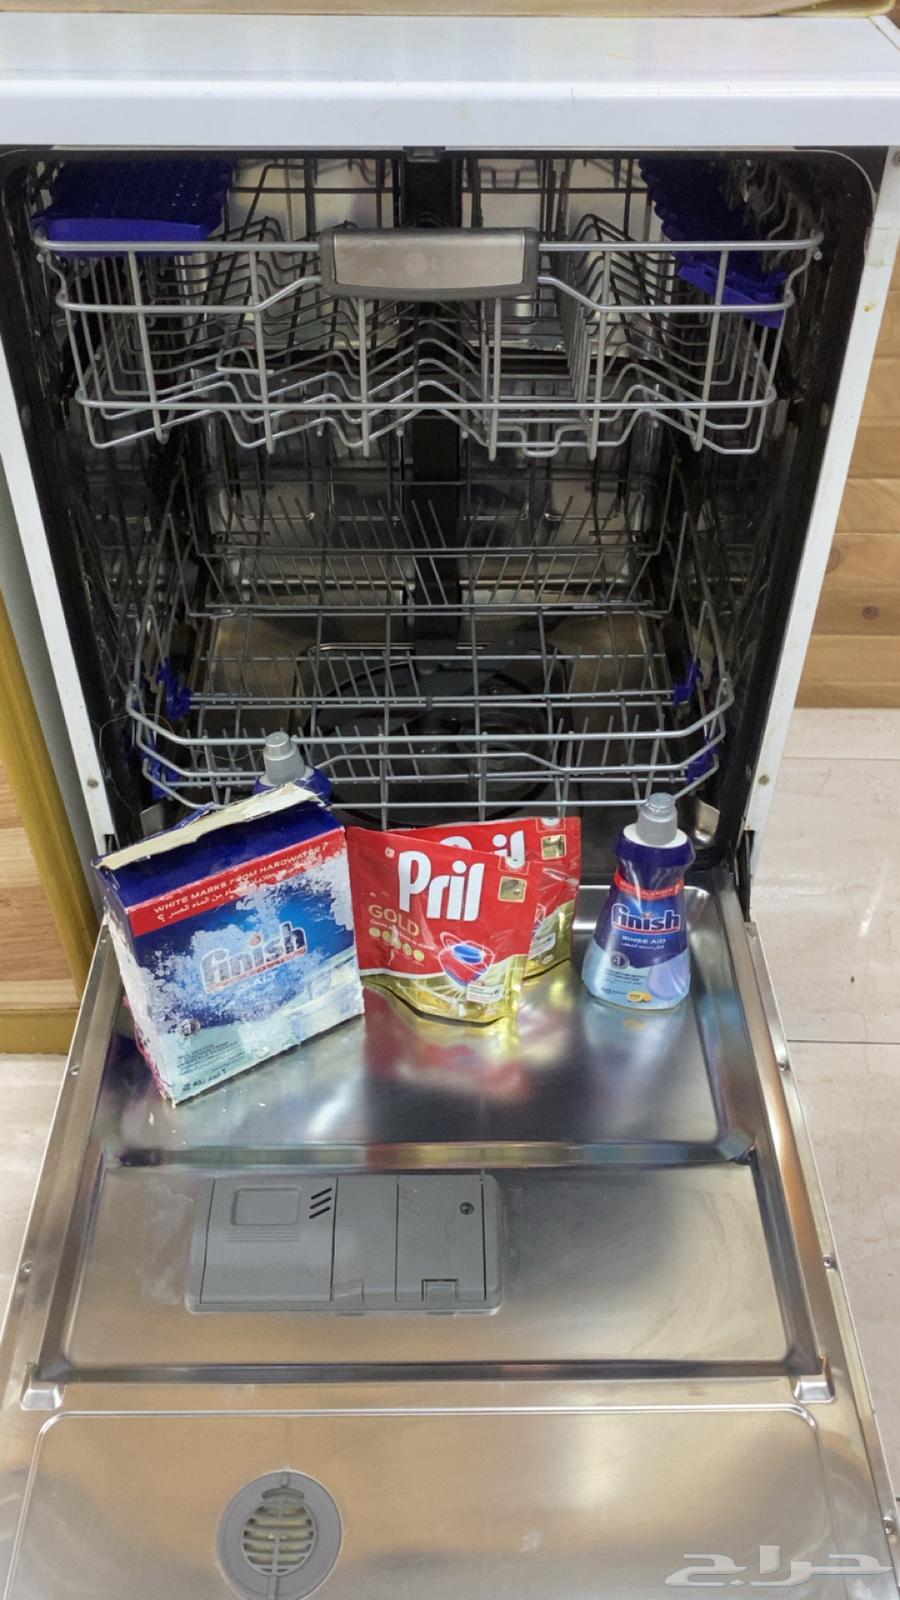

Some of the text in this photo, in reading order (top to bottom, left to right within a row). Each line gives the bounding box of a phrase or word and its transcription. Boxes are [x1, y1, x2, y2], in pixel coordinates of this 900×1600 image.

[154, 896, 188, 914] WHITE
[190, 882, 228, 898] MARKS
[229, 870, 258, 885] FROM
[399, 851, 485, 921] Pril
[368, 904, 420, 937] GOLD
[611, 903, 681, 932] finish
[201, 921, 307, 992] finish
[621, 935, 649, 945] RINSE
